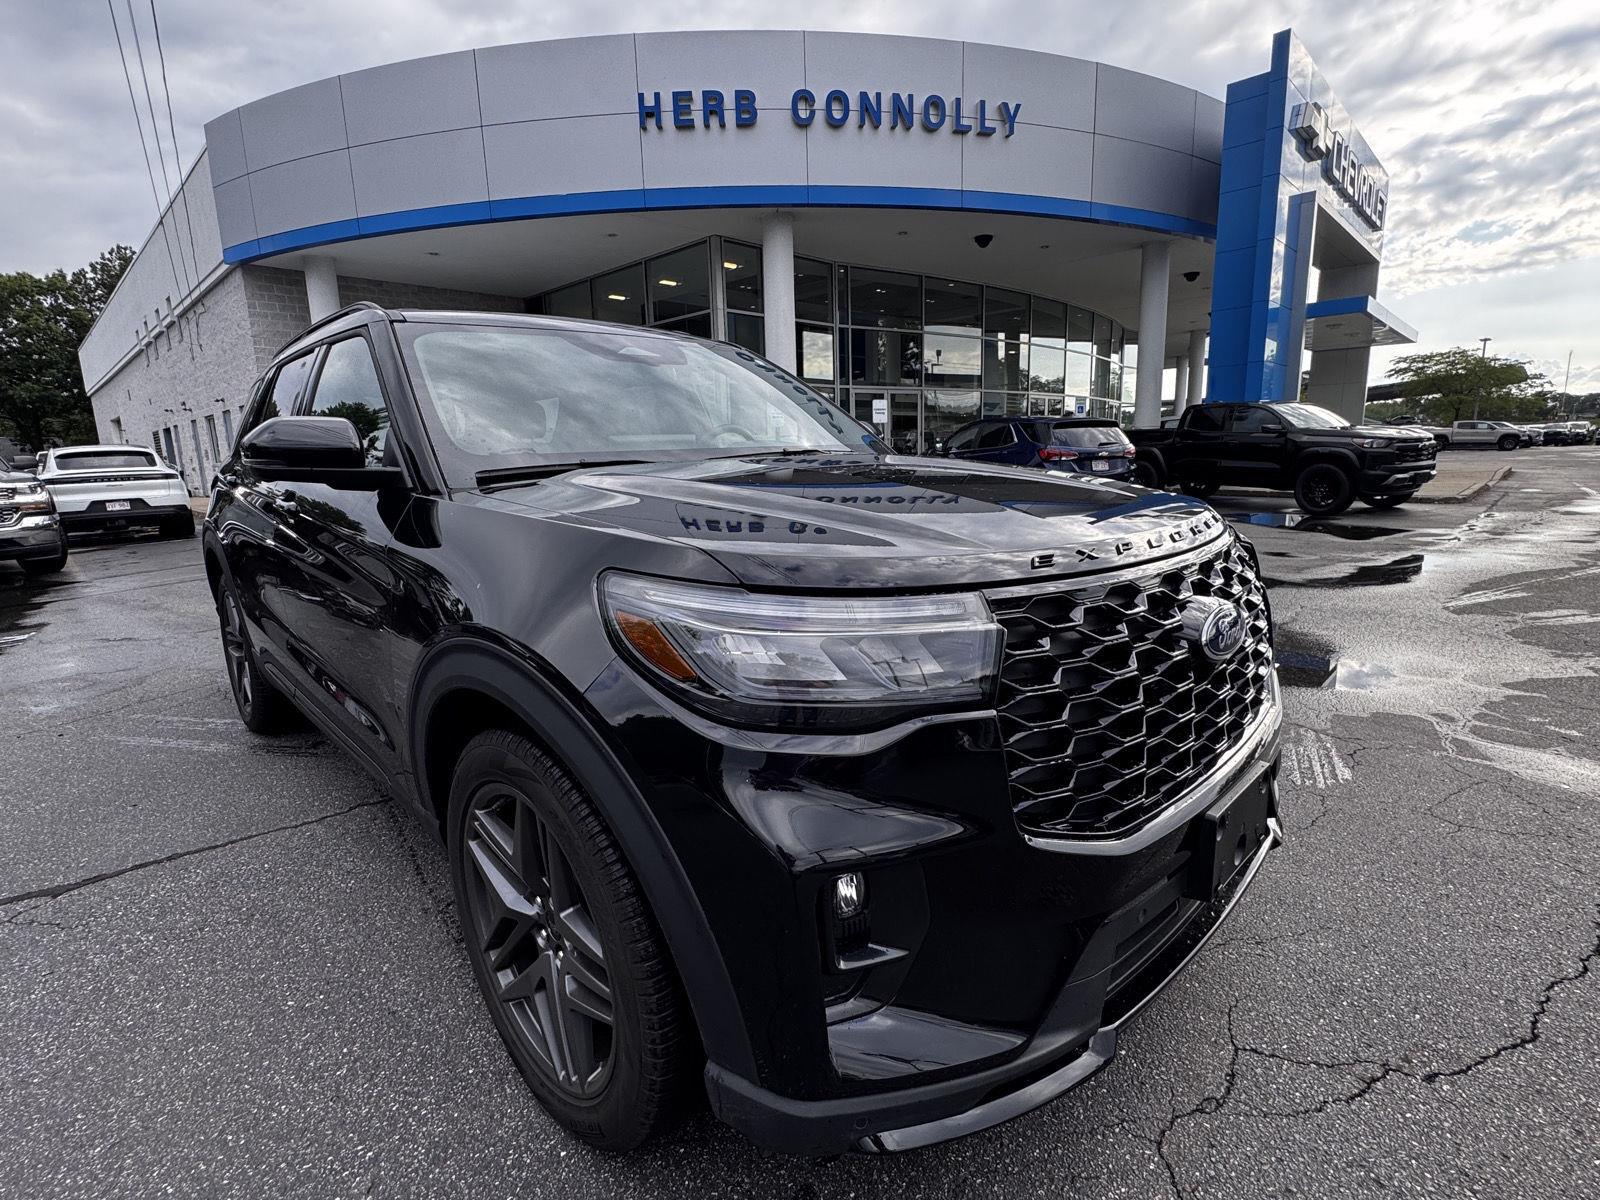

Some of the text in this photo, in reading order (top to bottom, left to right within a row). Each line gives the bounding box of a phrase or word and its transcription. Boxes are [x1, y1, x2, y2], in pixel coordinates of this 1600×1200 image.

[637, 89, 1022, 138] HERB CONNOLLY
[1330, 131, 1388, 230] CHEVROLET
